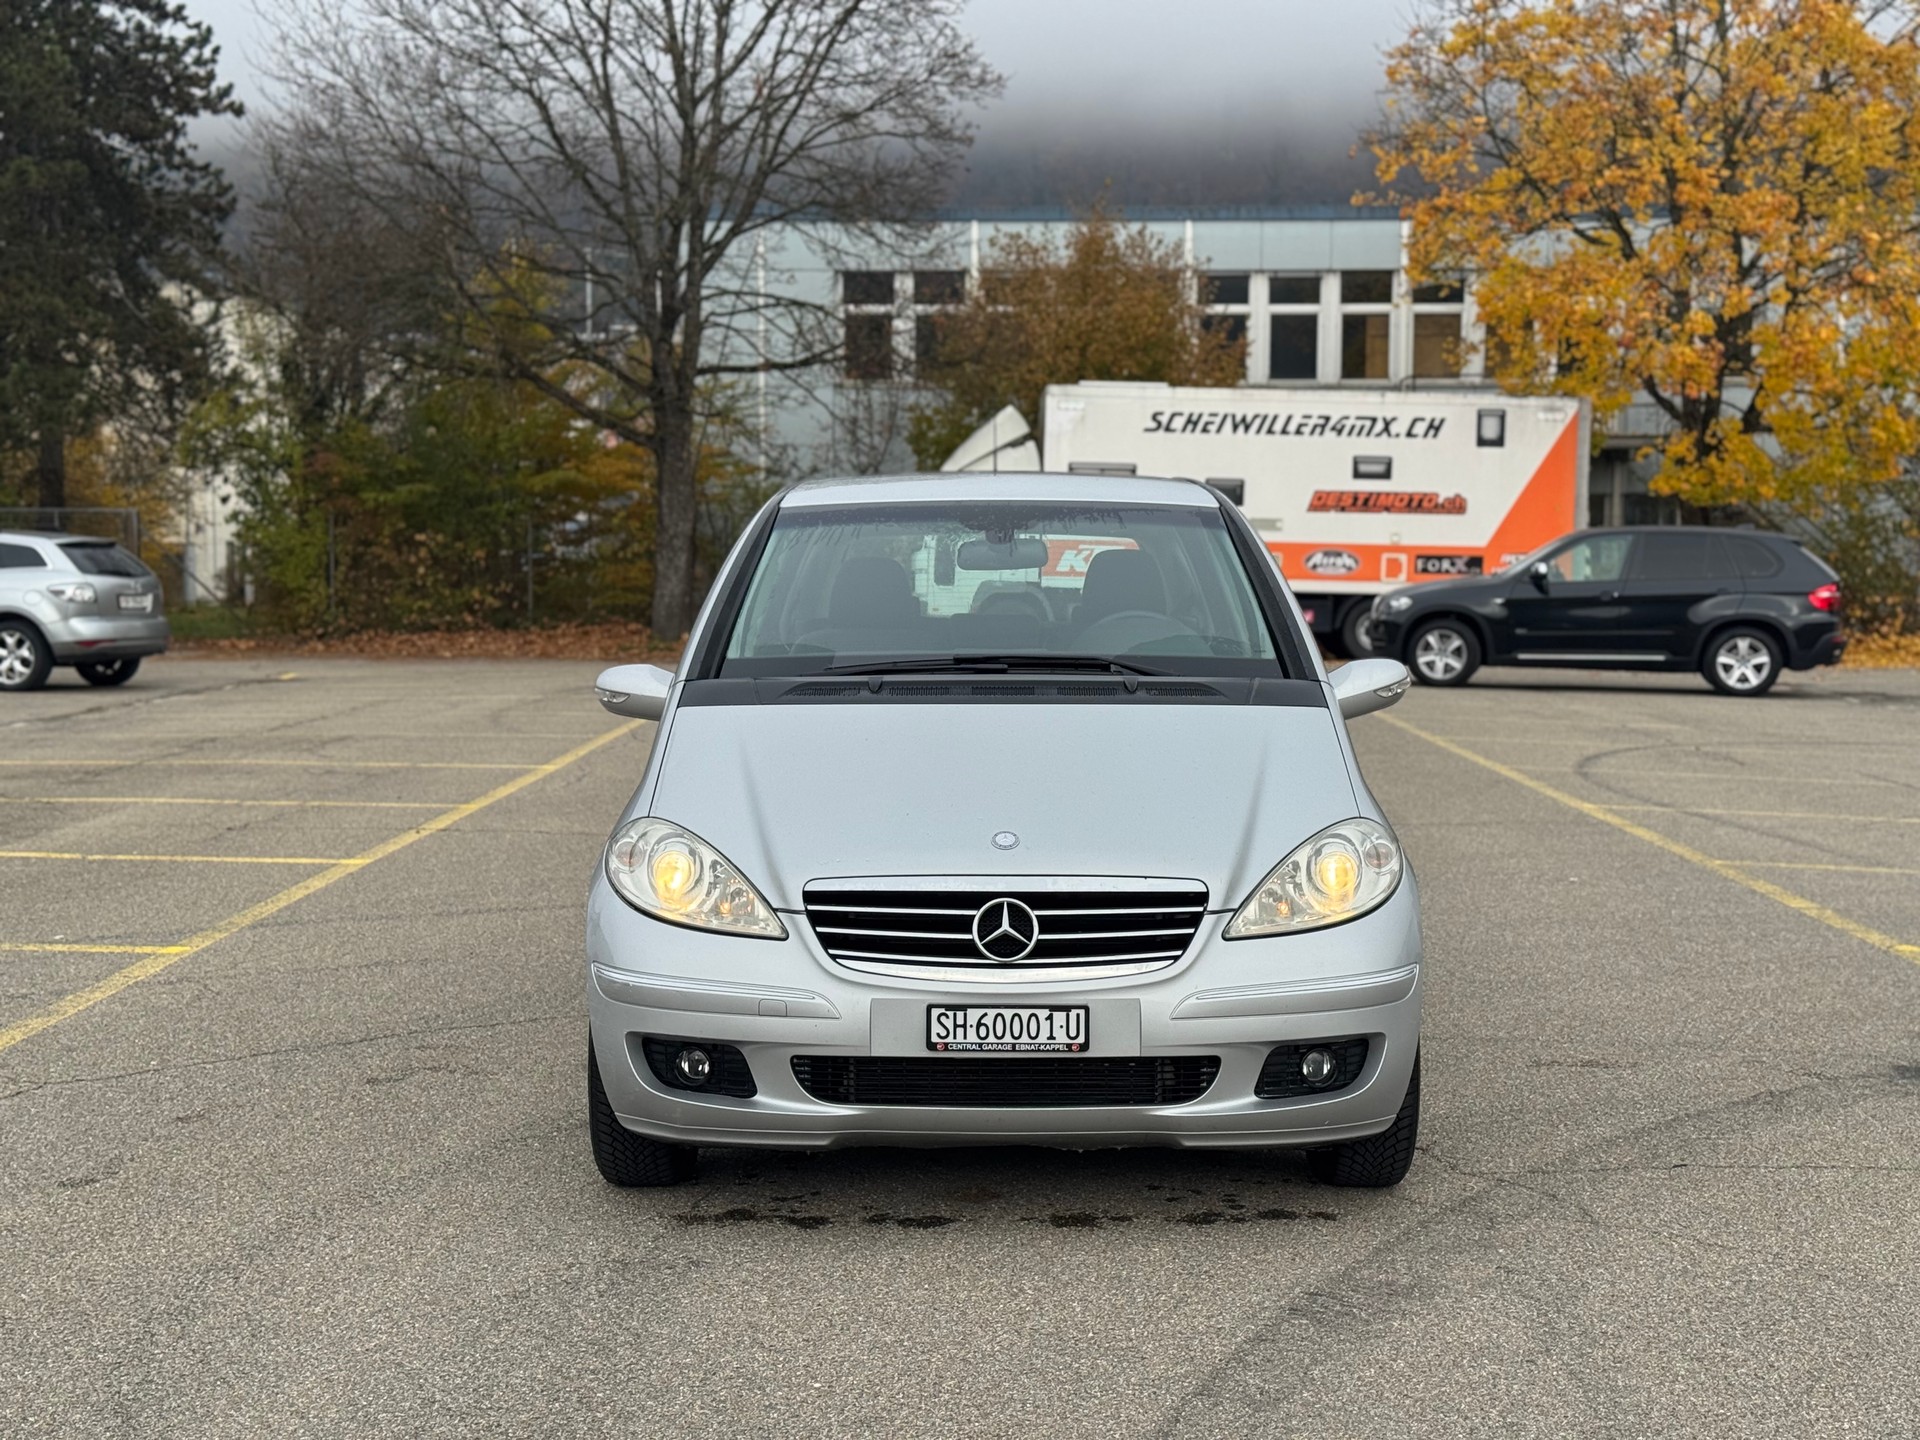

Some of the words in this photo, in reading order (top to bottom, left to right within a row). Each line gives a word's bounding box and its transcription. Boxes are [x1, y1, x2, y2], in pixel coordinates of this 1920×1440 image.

[1143, 411, 1446, 440] SCHEIWILLER4MX.CH
[947, 1043, 981, 1051] CENTRAL
[982, 1043, 1013, 1051] GARAGE
[1015, 1043, 1069, 1051] EBNAT-KAPPEL
